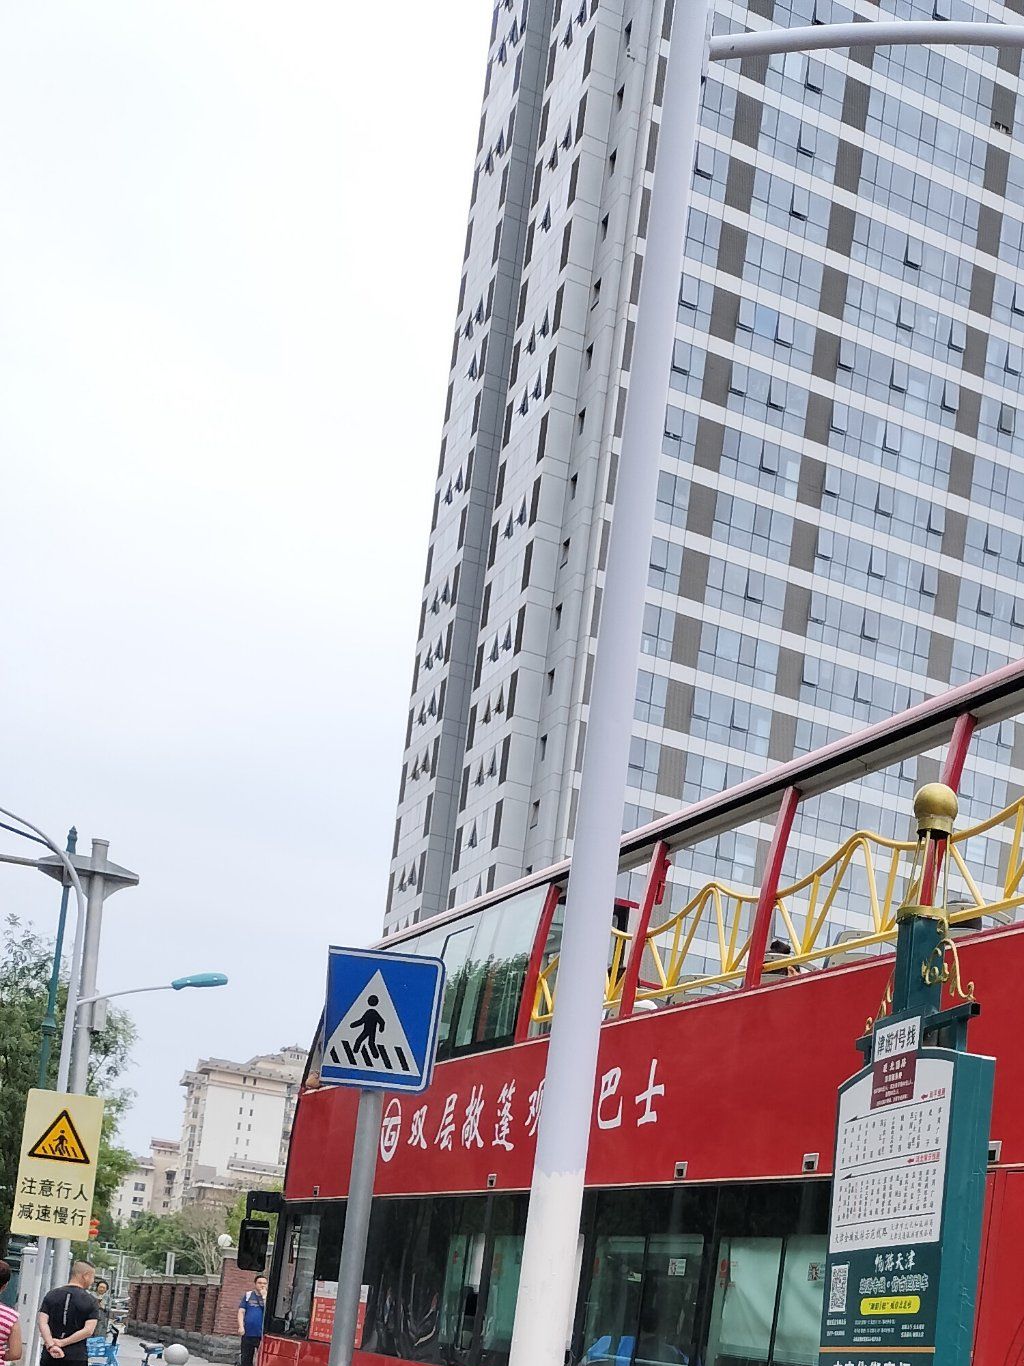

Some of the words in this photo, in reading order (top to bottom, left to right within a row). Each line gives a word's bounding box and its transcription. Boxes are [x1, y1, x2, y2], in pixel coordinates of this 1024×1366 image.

[20, 1177, 88, 1202] 注意行人
[17, 1202, 87, 1227] 减速慢行
[874, 1249, 916, 1273] 畅游天津
